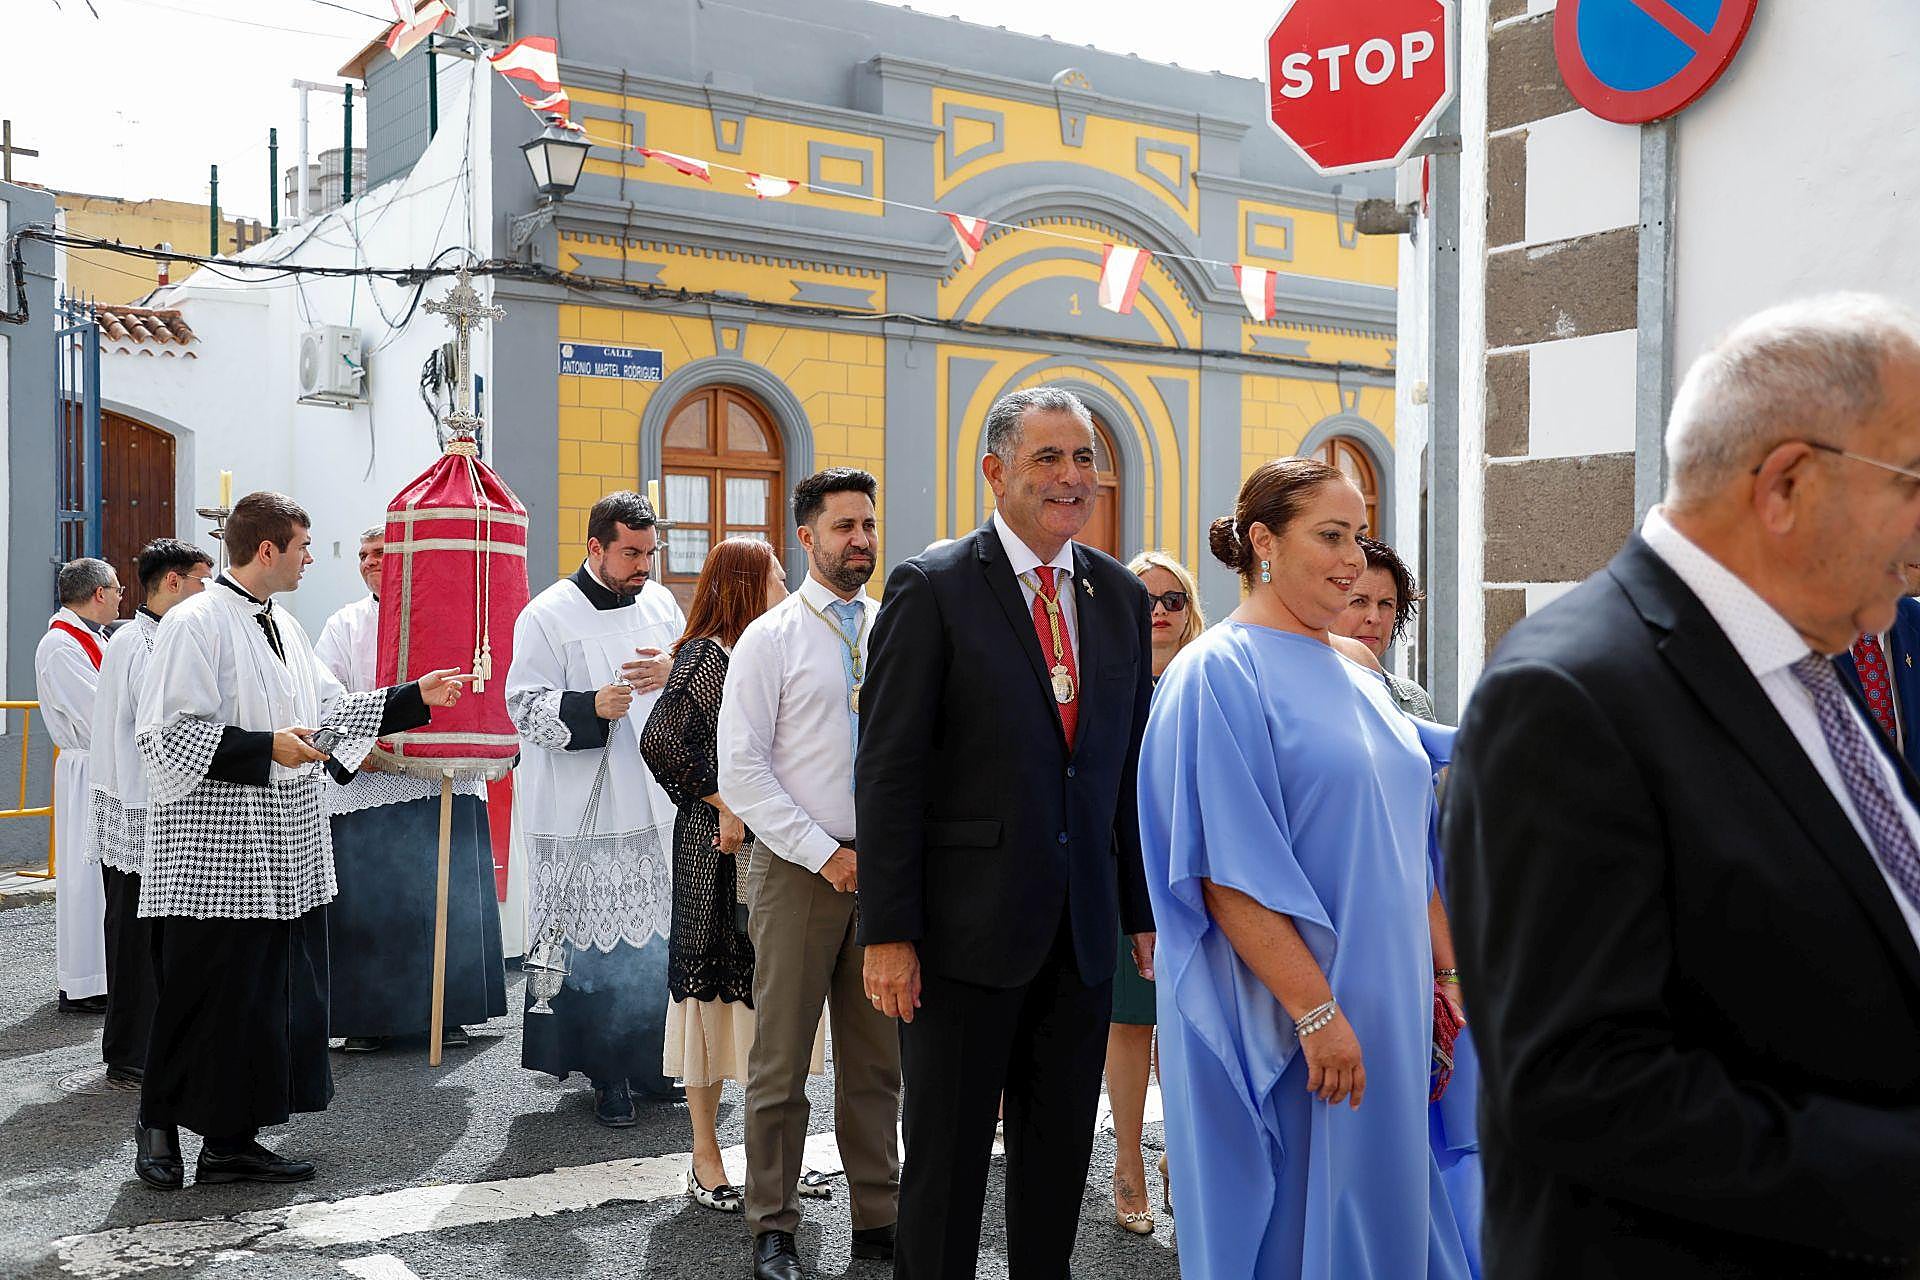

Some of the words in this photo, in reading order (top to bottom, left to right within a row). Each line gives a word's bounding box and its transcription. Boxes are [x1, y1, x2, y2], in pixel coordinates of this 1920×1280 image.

[1280, 30, 1435, 98] STOP
[1070, 293, 1082, 315] 1
[603, 348, 633, 358] CALLE
[562, 361, 591, 375] ANTONIO
[594, 363, 620, 377] MARTEL
